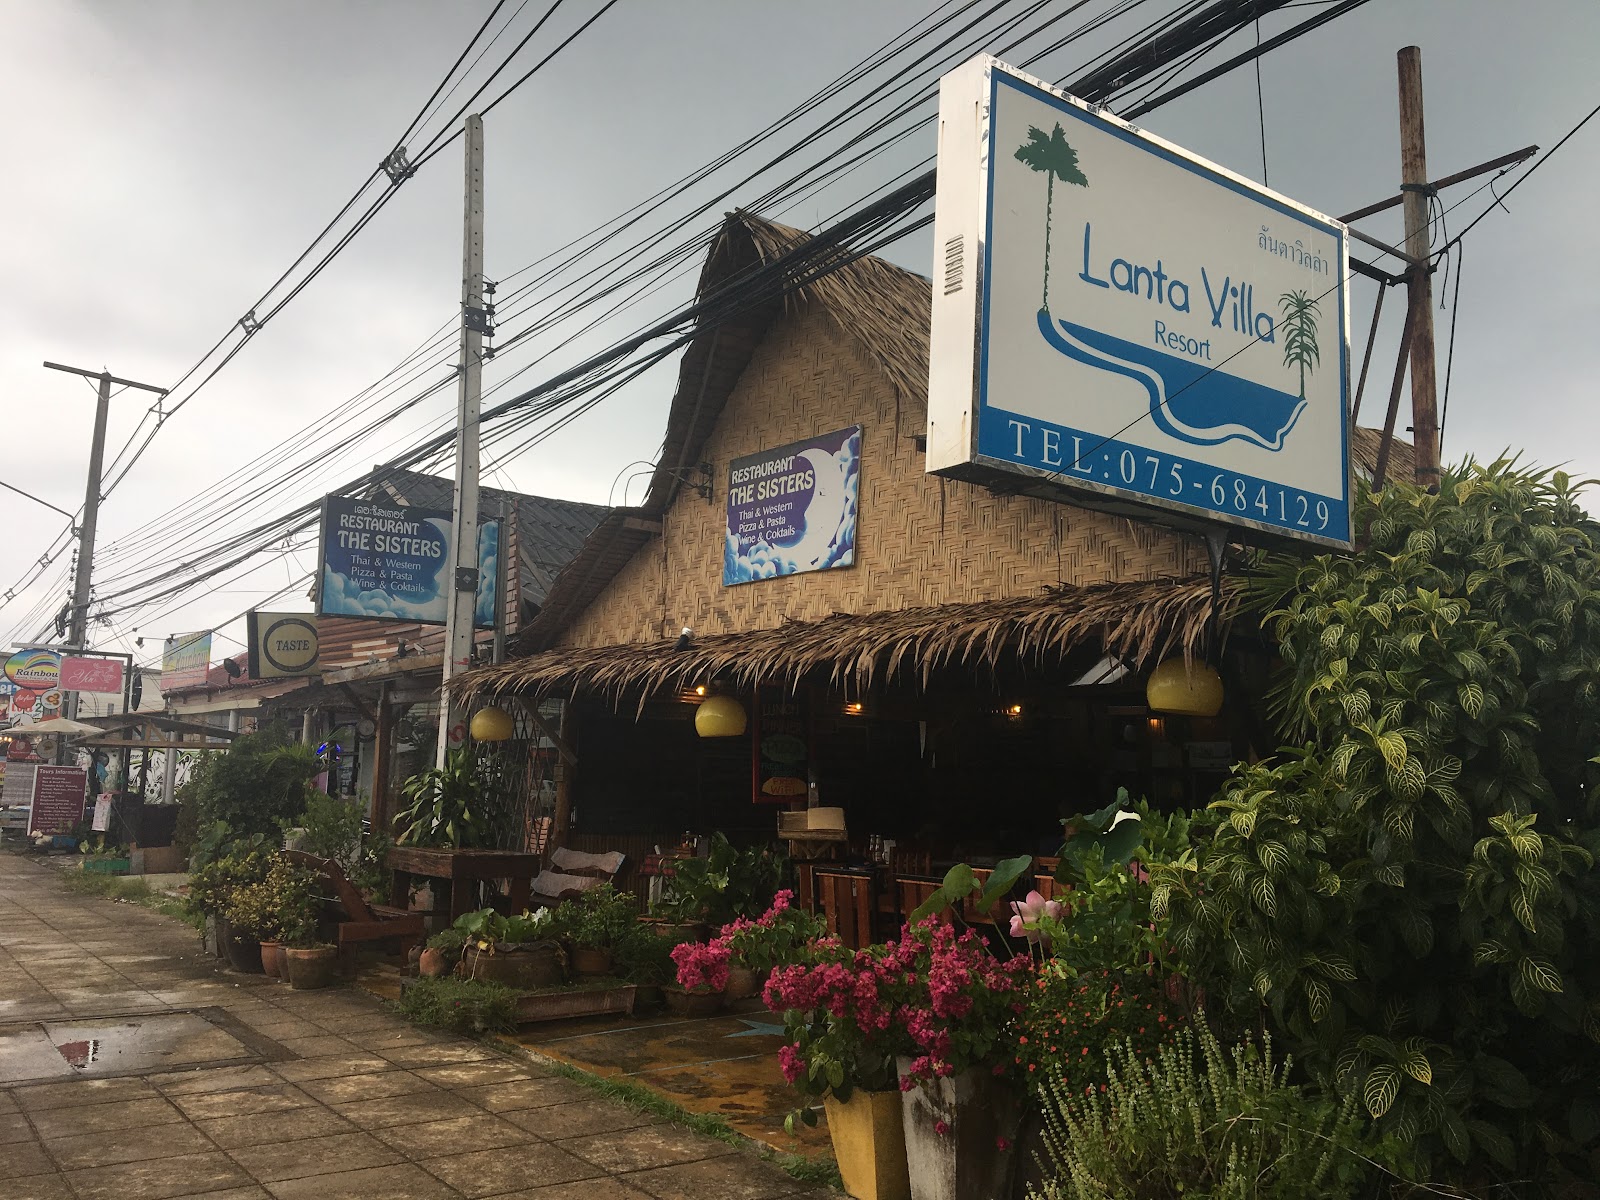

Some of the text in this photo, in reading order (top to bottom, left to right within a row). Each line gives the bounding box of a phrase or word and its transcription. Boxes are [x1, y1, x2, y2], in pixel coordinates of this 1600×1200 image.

[1259, 225, 1328, 276] ลันตาวิลล่า
[1079, 222, 1275, 345] Lanta Villa
[1155, 320, 1211, 361] Resort
[731, 456, 795, 484] RESTAURANT
[730, 470, 814, 506] THE SISTERS
[738, 502, 793, 520] Thai & Western
[340, 514, 420, 535] RESTAURANT
[738, 515, 786, 533] Pizza & Pasta
[338, 531, 441, 558] THE SISTERS
[738, 525, 795, 546] Wine & Coktails
[351, 555, 421, 570] Thai & Western
[351, 566, 412, 580] Pizza & Pasta
[351, 578, 425, 592] Wine & Coktails
[276, 639, 310, 651] TASTE
